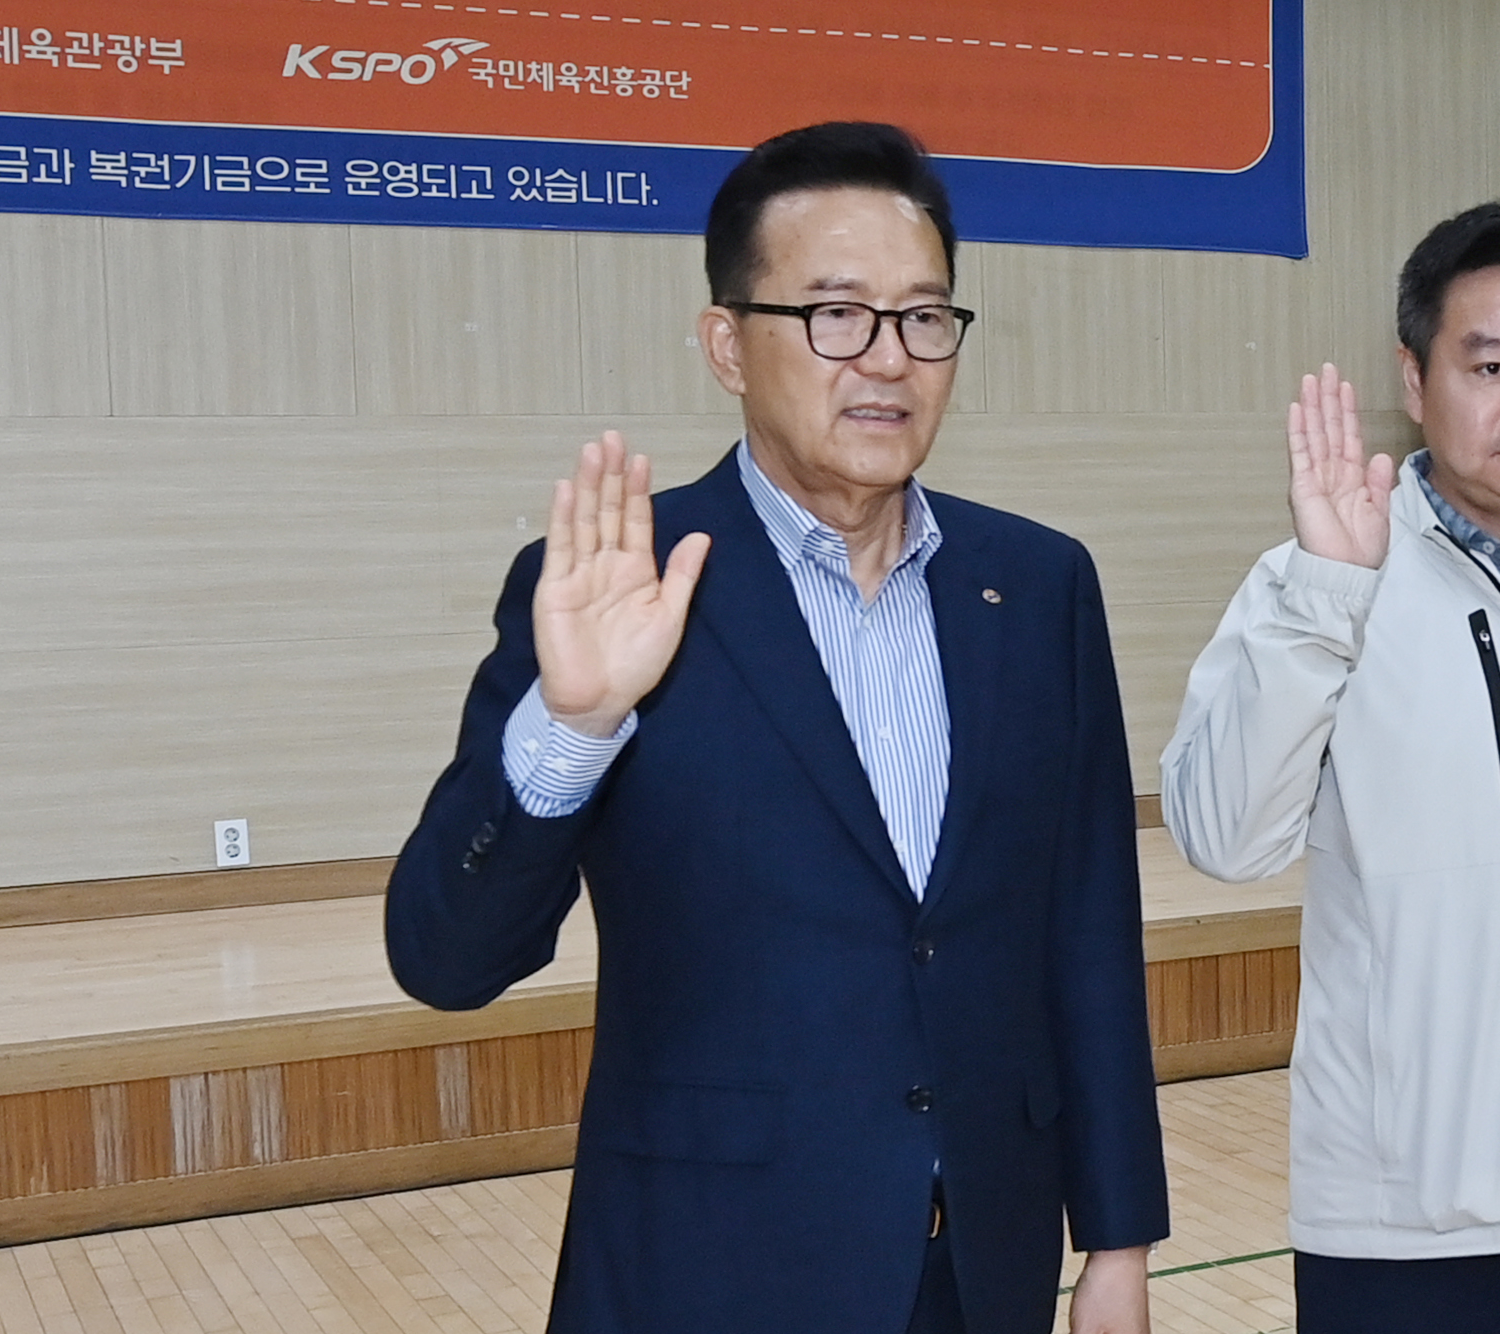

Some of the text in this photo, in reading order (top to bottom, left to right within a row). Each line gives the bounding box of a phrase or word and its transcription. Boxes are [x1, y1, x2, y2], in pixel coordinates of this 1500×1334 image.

[282, 43, 436, 85] KSPO
[468, 58, 692, 99] 국민체육진흥공단
[89, 150, 331, 194] 복권기금으로
[345, 160, 495, 200] 운영되고
[508, 167, 658, 206] 있습니다.
